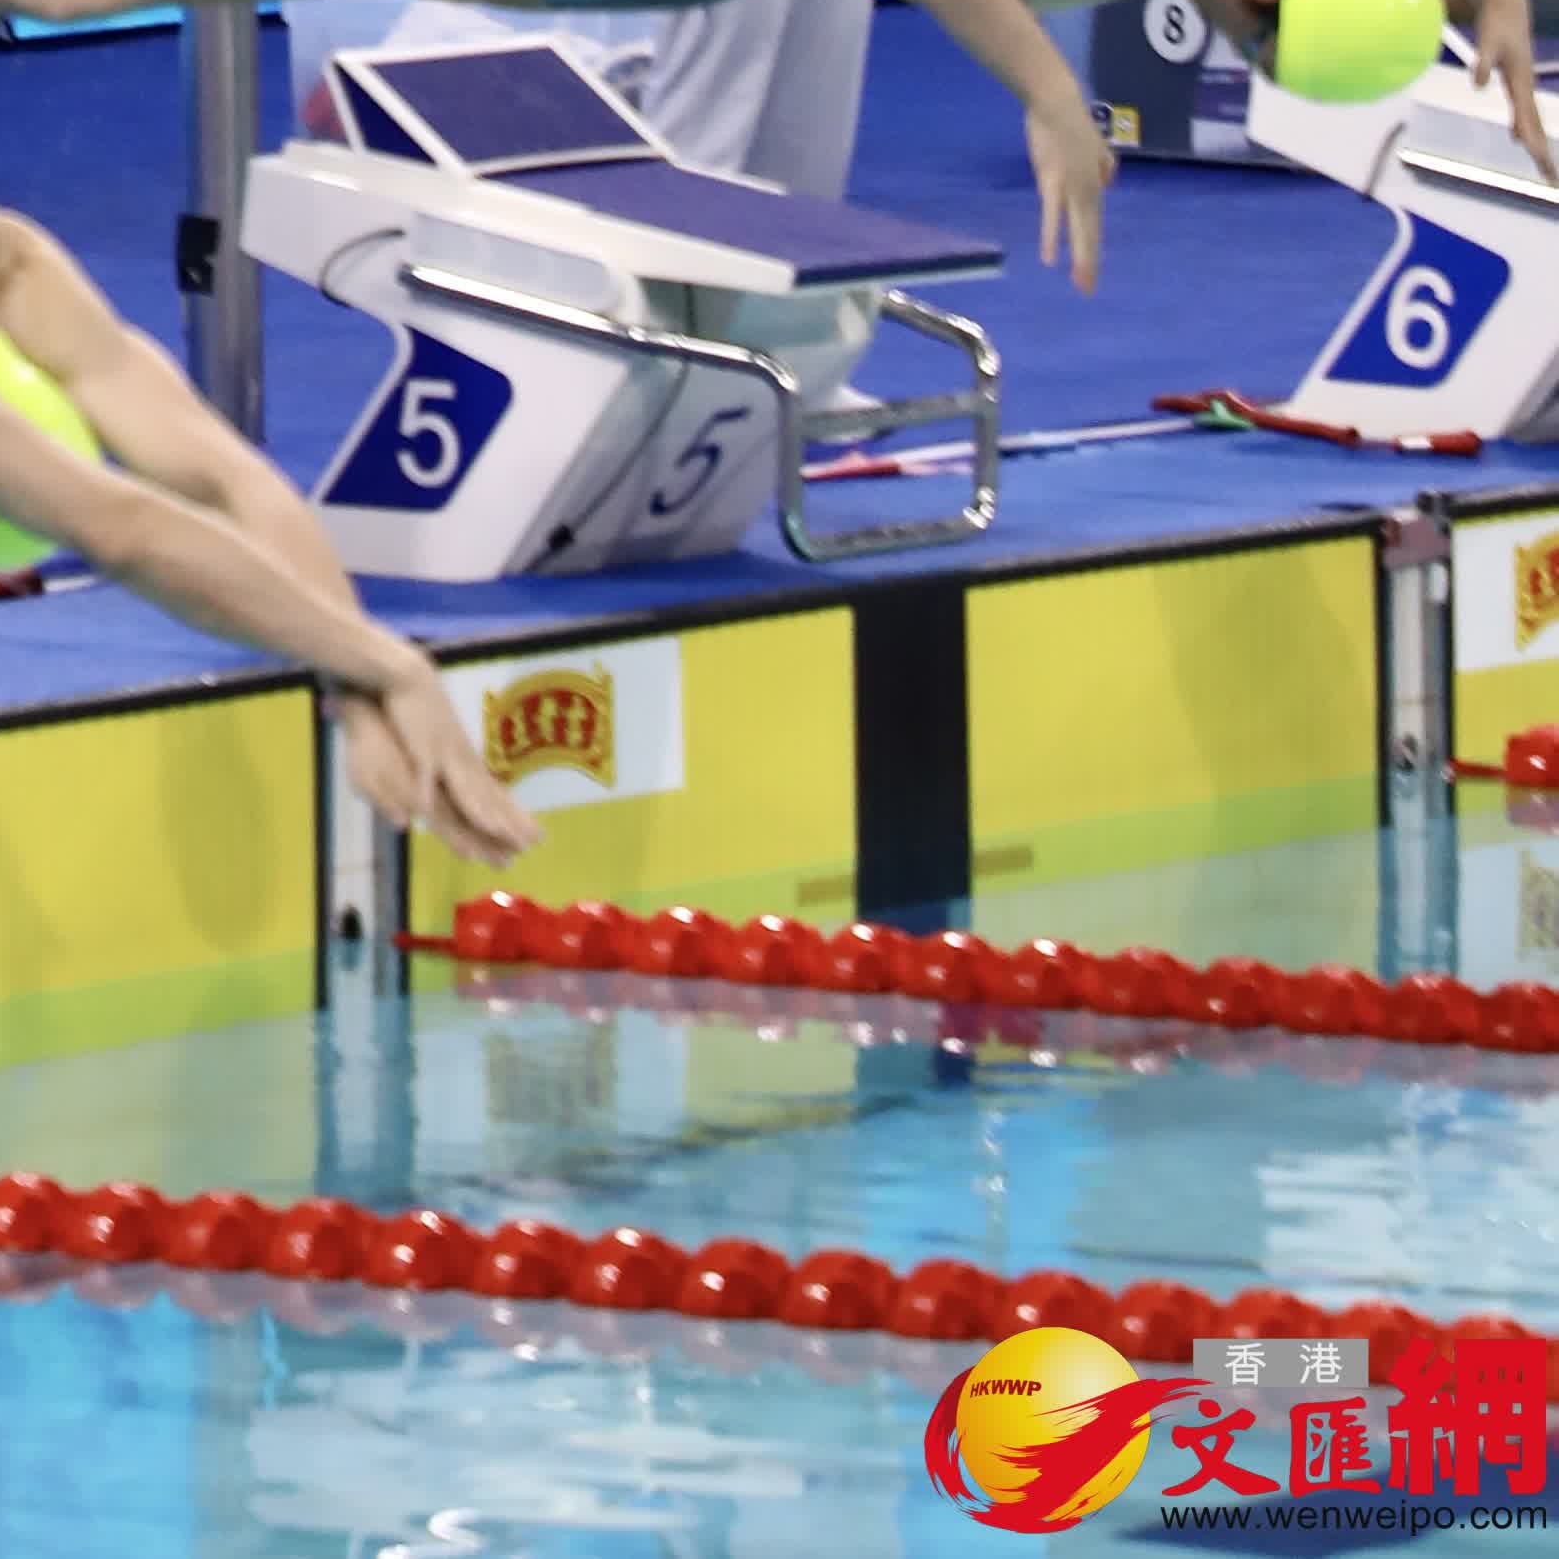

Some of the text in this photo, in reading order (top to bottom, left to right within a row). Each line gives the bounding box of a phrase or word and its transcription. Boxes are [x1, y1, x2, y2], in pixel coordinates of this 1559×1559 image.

[1386, 267, 1457, 371] 6
[396, 377, 462, 487] 5
[650, 407, 752, 515] 5
